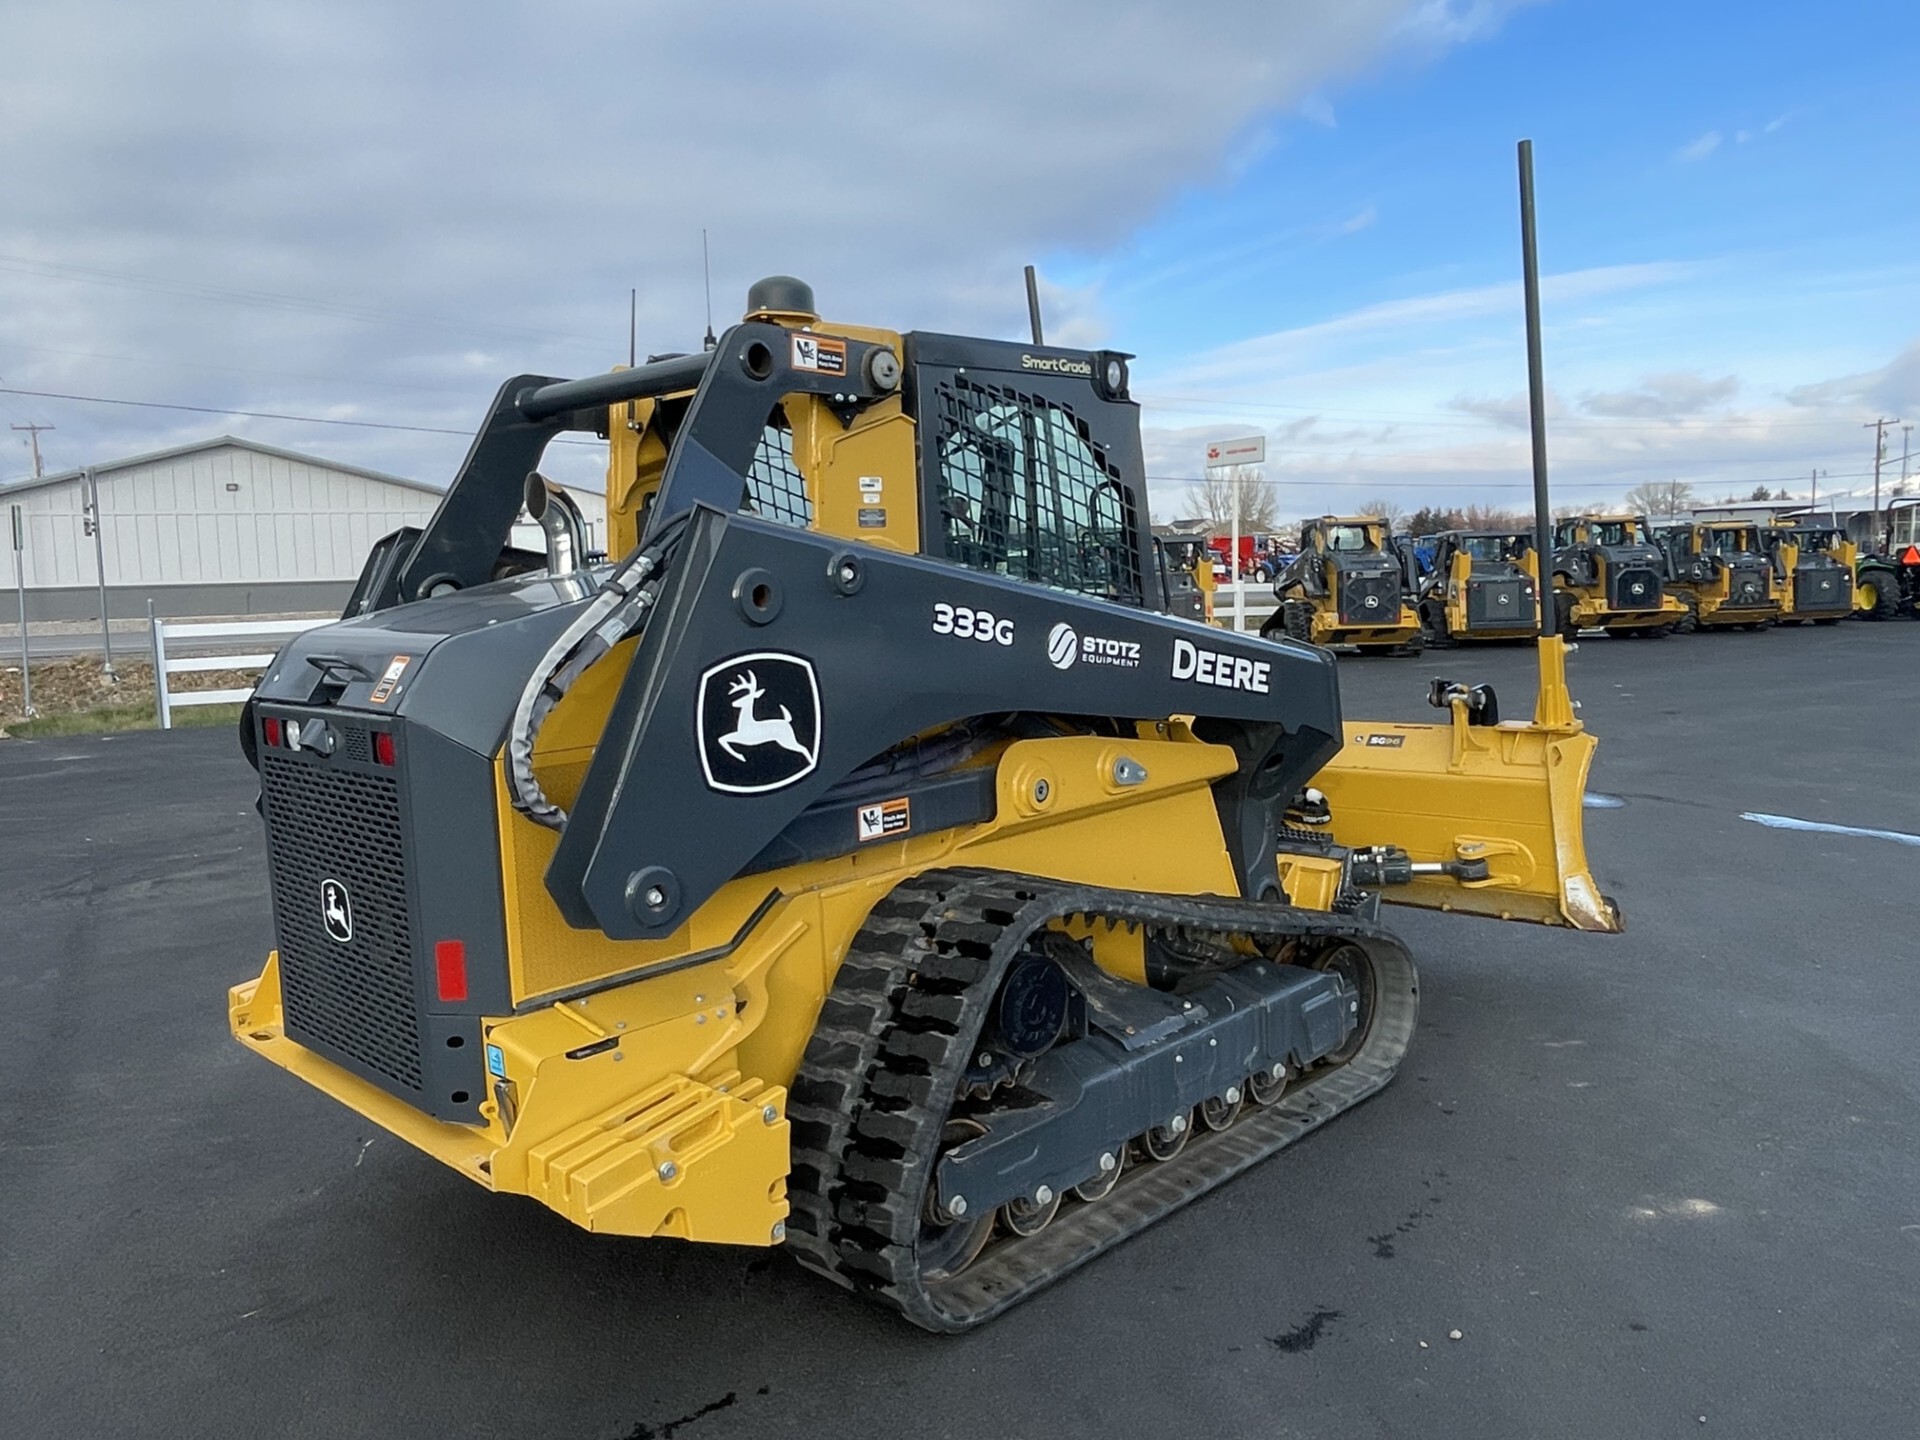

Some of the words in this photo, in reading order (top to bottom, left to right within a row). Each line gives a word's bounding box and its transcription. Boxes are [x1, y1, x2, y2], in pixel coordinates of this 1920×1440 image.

[932, 603, 1014, 645] 333G
[1082, 636, 1141, 659] STOTZ
[1082, 653, 1140, 668] EQUIPMENT
[1172, 639, 1271, 693] DEERE
